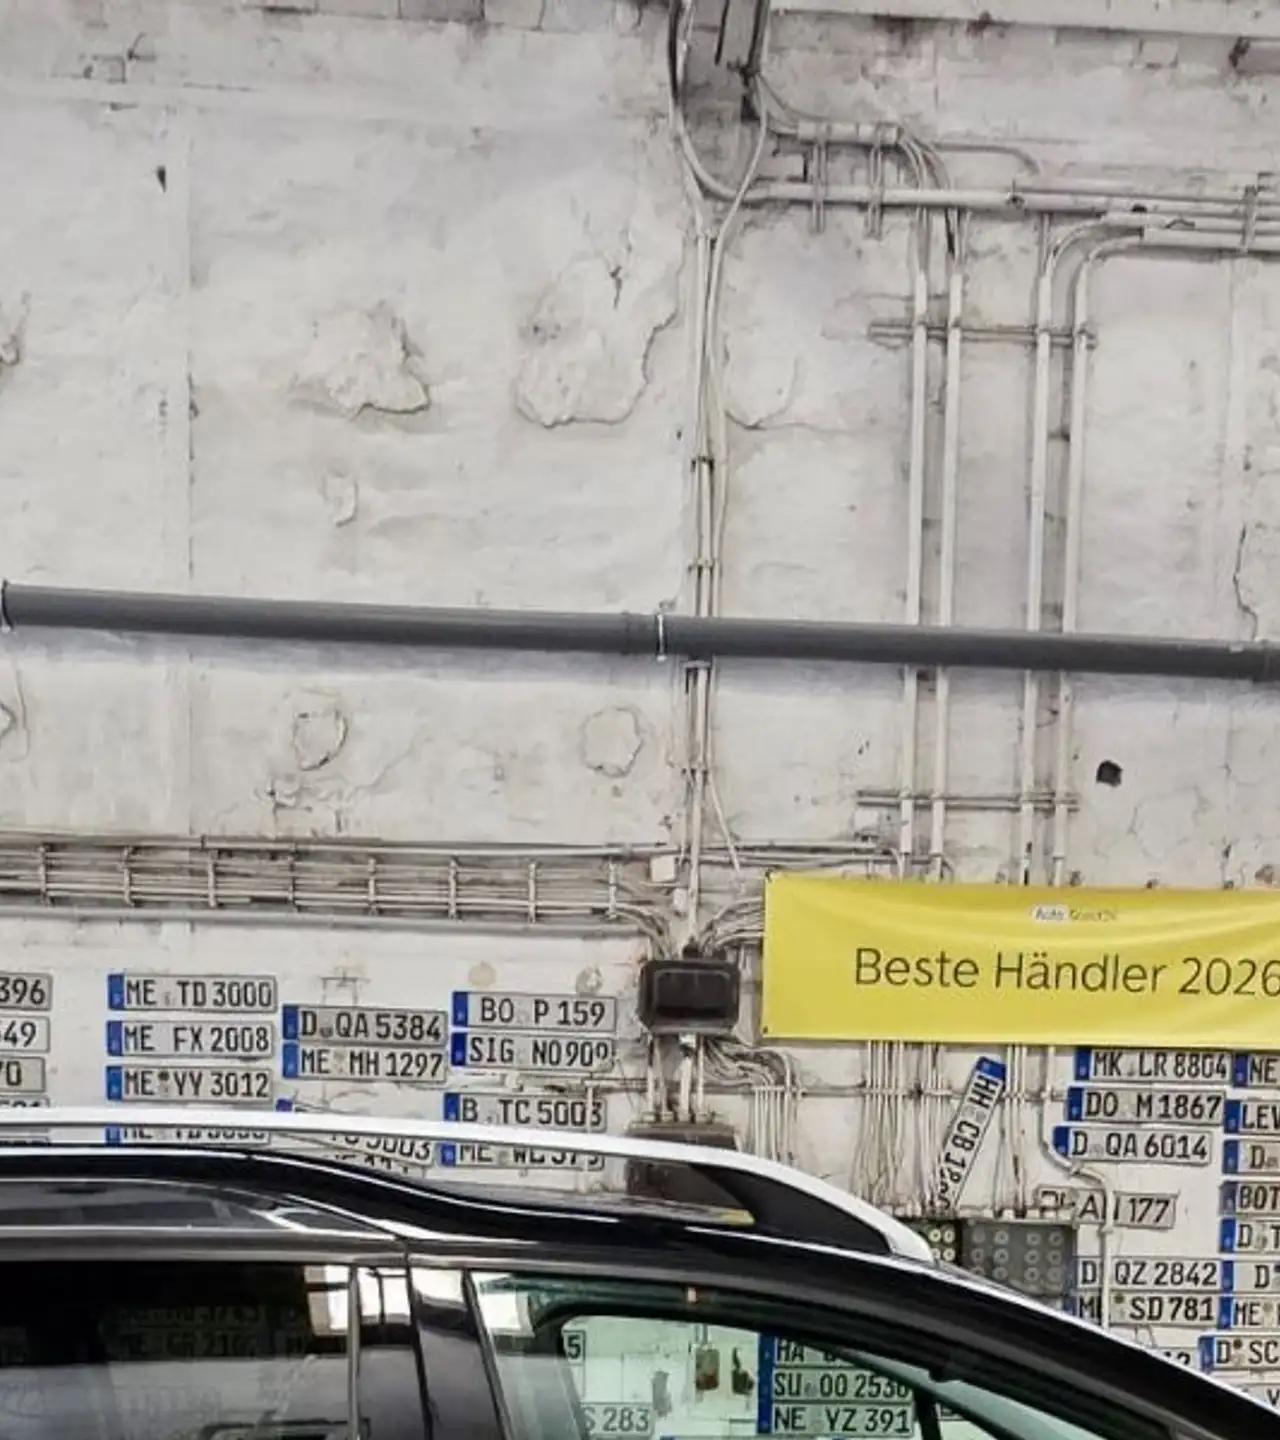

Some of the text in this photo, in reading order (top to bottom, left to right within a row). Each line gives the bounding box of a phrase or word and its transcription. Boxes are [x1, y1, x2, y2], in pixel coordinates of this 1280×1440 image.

[854, 947, 979, 988] Beste
[995, 950, 1166, 994] Händler
[124, 981, 272, 1008] ME TD 3000
[300, 1010, 442, 1041] D QA 5384
[479, 998, 606, 1027] BO P 159
[123, 1024, 269, 1053] ME FX 2008
[1085, 1091, 1222, 1120] DO M 1867
[1071, 1132, 1208, 1160] D QA 6014
[1249, 1145, 1265, 1169] D
[1128, 1197, 1170, 1223] 177
[1255, 1265, 1270, 1289] D
[1216, 1339, 1232, 1363] D
[1248, 1339, 1280, 1363] SC
[774, 1406, 910, 1434] NE YZ 391
